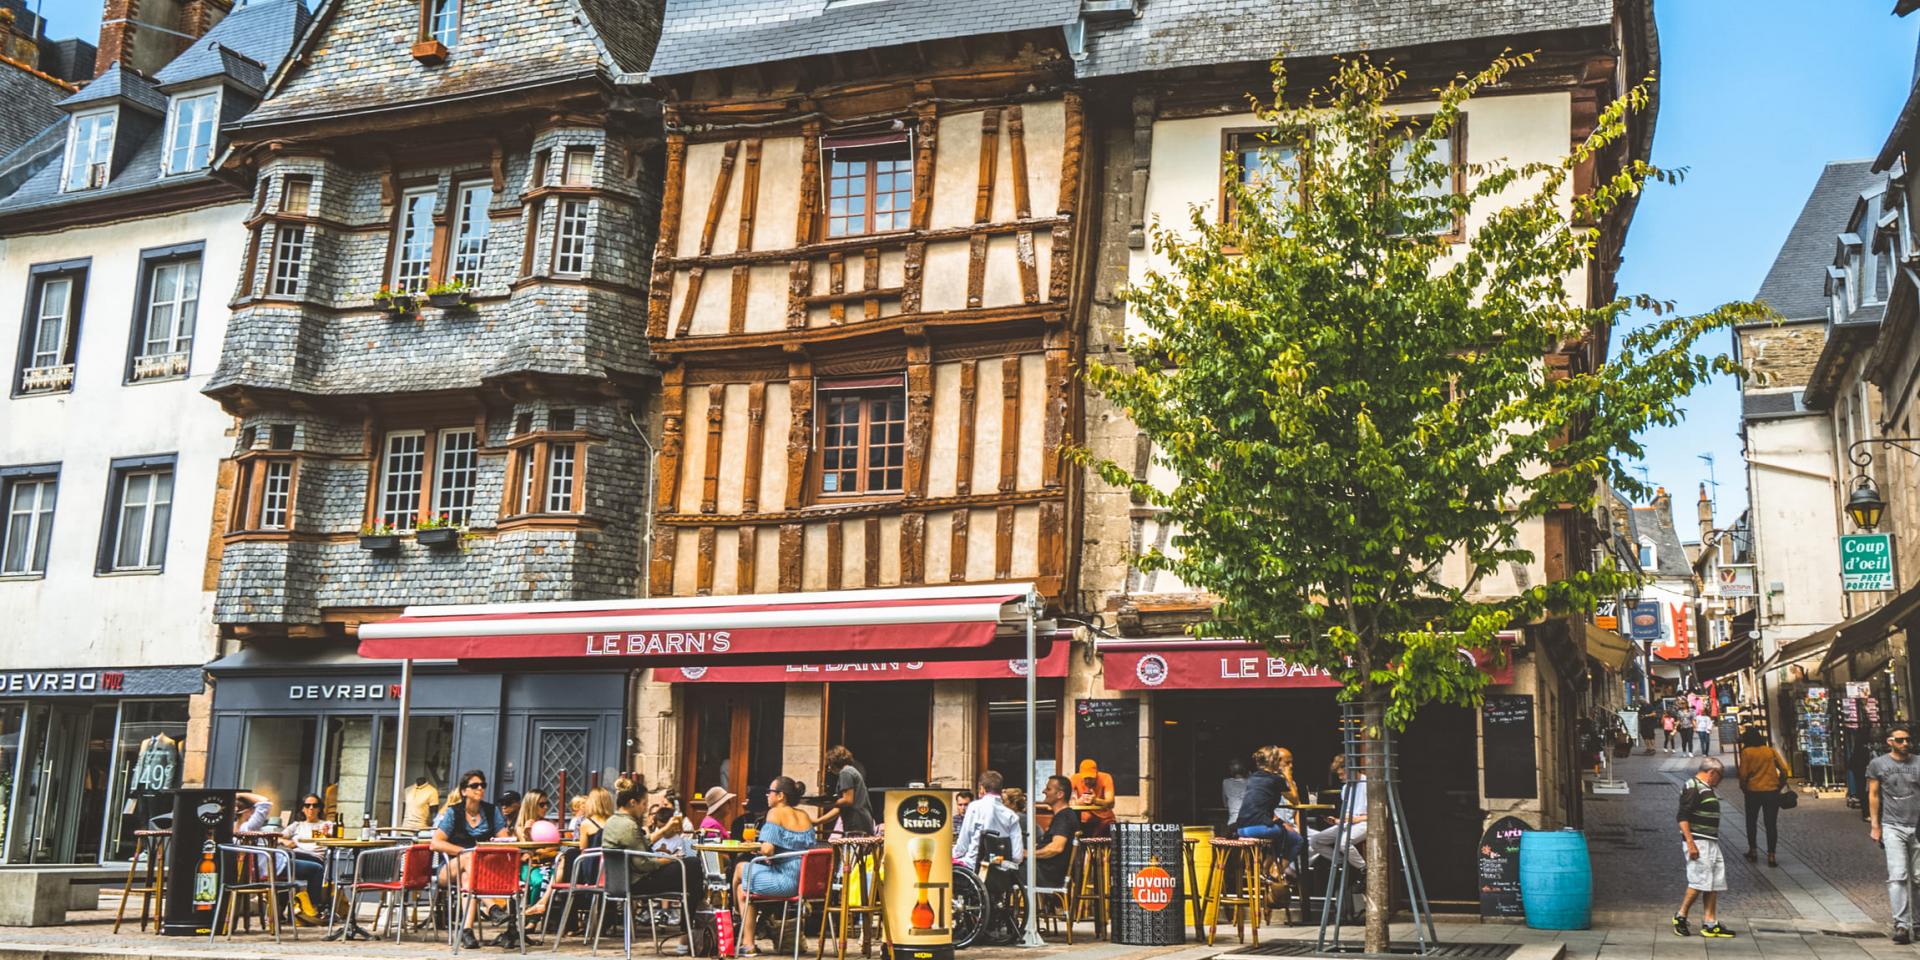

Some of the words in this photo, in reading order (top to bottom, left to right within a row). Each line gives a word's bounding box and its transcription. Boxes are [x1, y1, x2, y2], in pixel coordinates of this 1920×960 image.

[1845, 540, 1885, 555] Coup
[1845, 556, 1888, 570] d'oeil
[1860, 574, 1883, 582] PRET
[1845, 582, 1881, 590] PORTER
[586, 635, 621, 655] LE
[626, 632, 730, 654] BARN'S
[1221, 657, 1259, 678] LE
[289, 684, 384, 699] DEVRED
[1151, 823, 1180, 832] CUBA
[1128, 872, 1176, 888] Havana
[1138, 888, 1168, 903] Club
